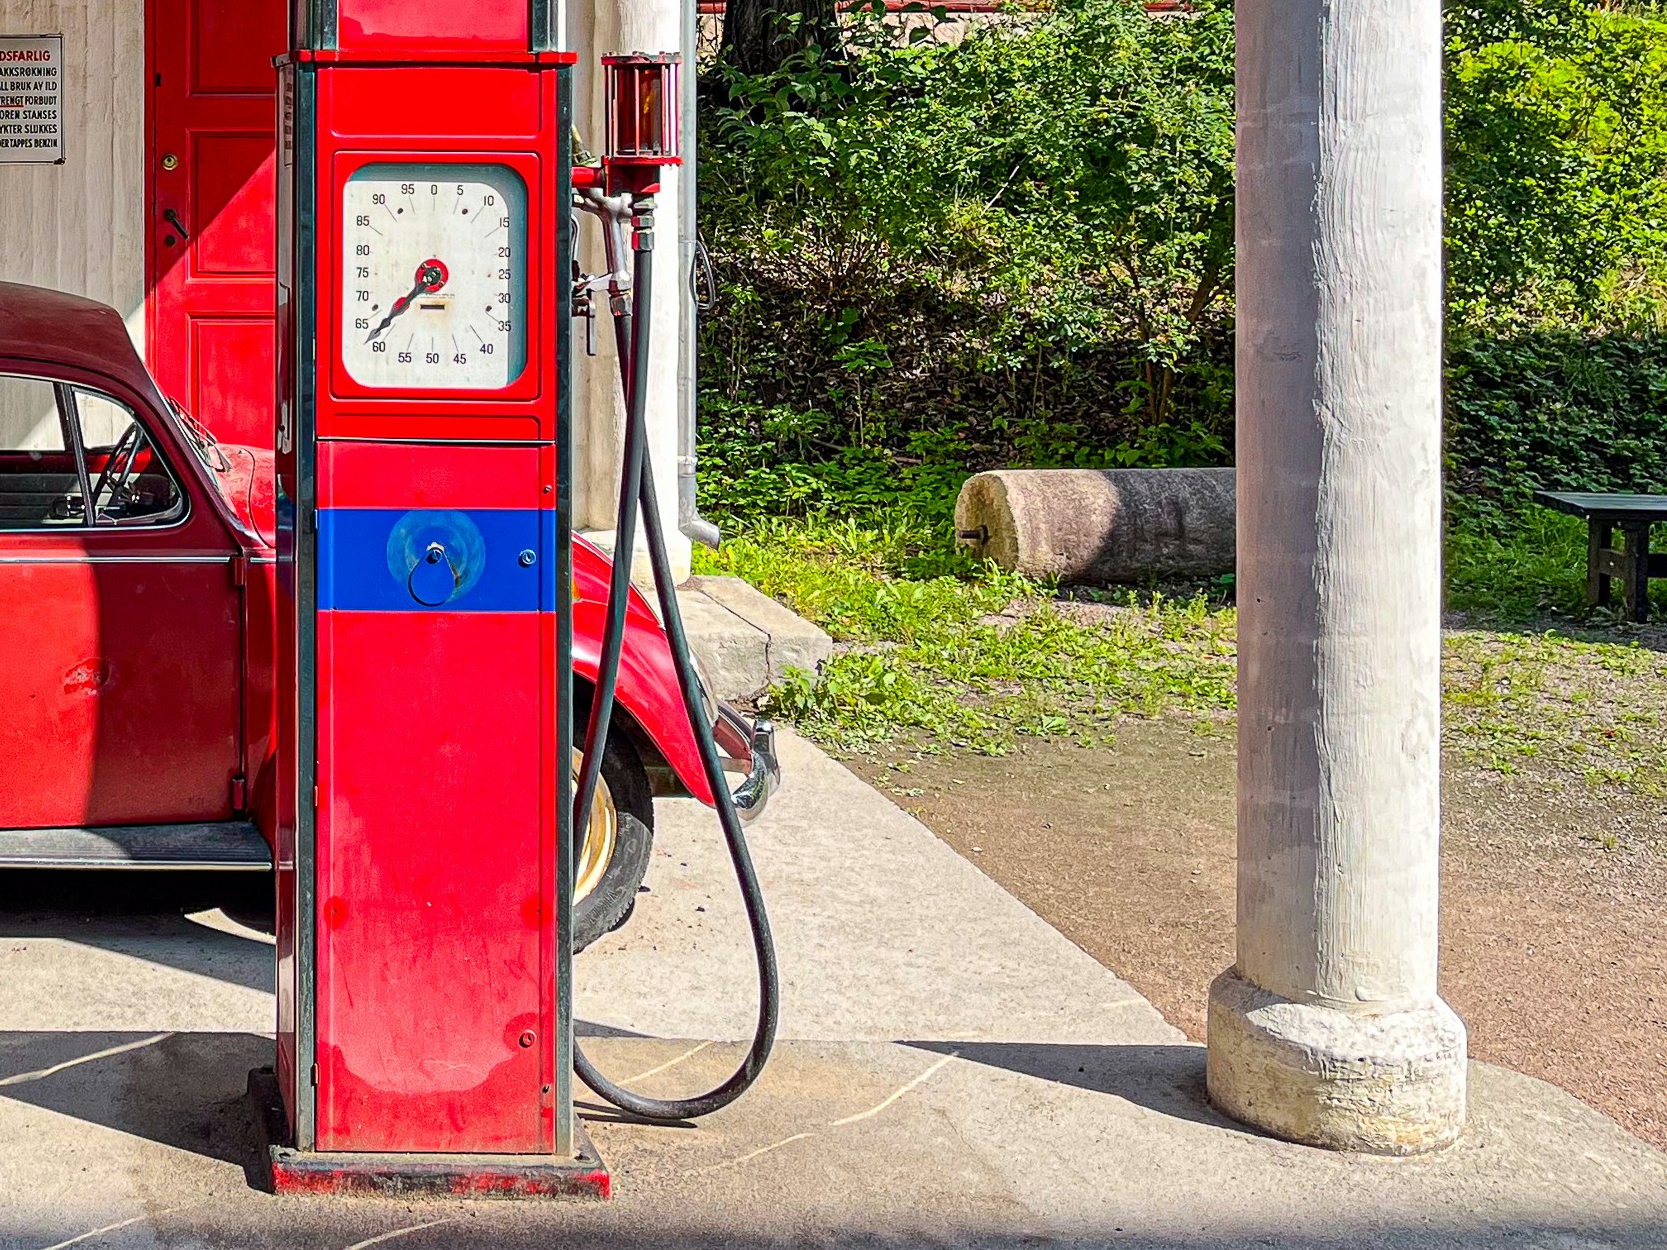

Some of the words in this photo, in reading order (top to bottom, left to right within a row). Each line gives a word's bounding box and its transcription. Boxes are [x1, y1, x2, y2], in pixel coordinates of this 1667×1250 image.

[10, 81, 31, 91] BRUK
[33, 81, 43, 91] AV
[45, 81, 57, 91] ILD
[25, 96, 57, 105] FORBUDT
[22, 110, 57, 120] STANSES
[24, 124, 58, 134] SLUKKES
[10, 138, 32, 148] TAPPES
[34, 138, 58, 148] BENZIN
[401, 184, 415, 194] 95
[431, 184, 438, 195] 0
[457, 185, 464, 195] 5
[372, 194, 385, 205] 90
[483, 196, 494, 206] 10
[356, 216, 370, 226] 85
[499, 217, 509, 227] 15
[356, 245, 370, 255] 80
[498, 247, 511, 257] 20
[356, 267, 369, 278] 75
[498, 269, 511, 280] 25
[356, 291, 369, 301] 70
[498, 293, 511, 304] 30
[355, 319, 369, 329] 65
[498, 321, 511, 331] 35
[372, 342, 386, 352] 60
[479, 343, 493, 354] 40
[398, 352, 412, 363] 55
[426, 353, 439, 364] 50
[453, 353, 466, 364] 45
